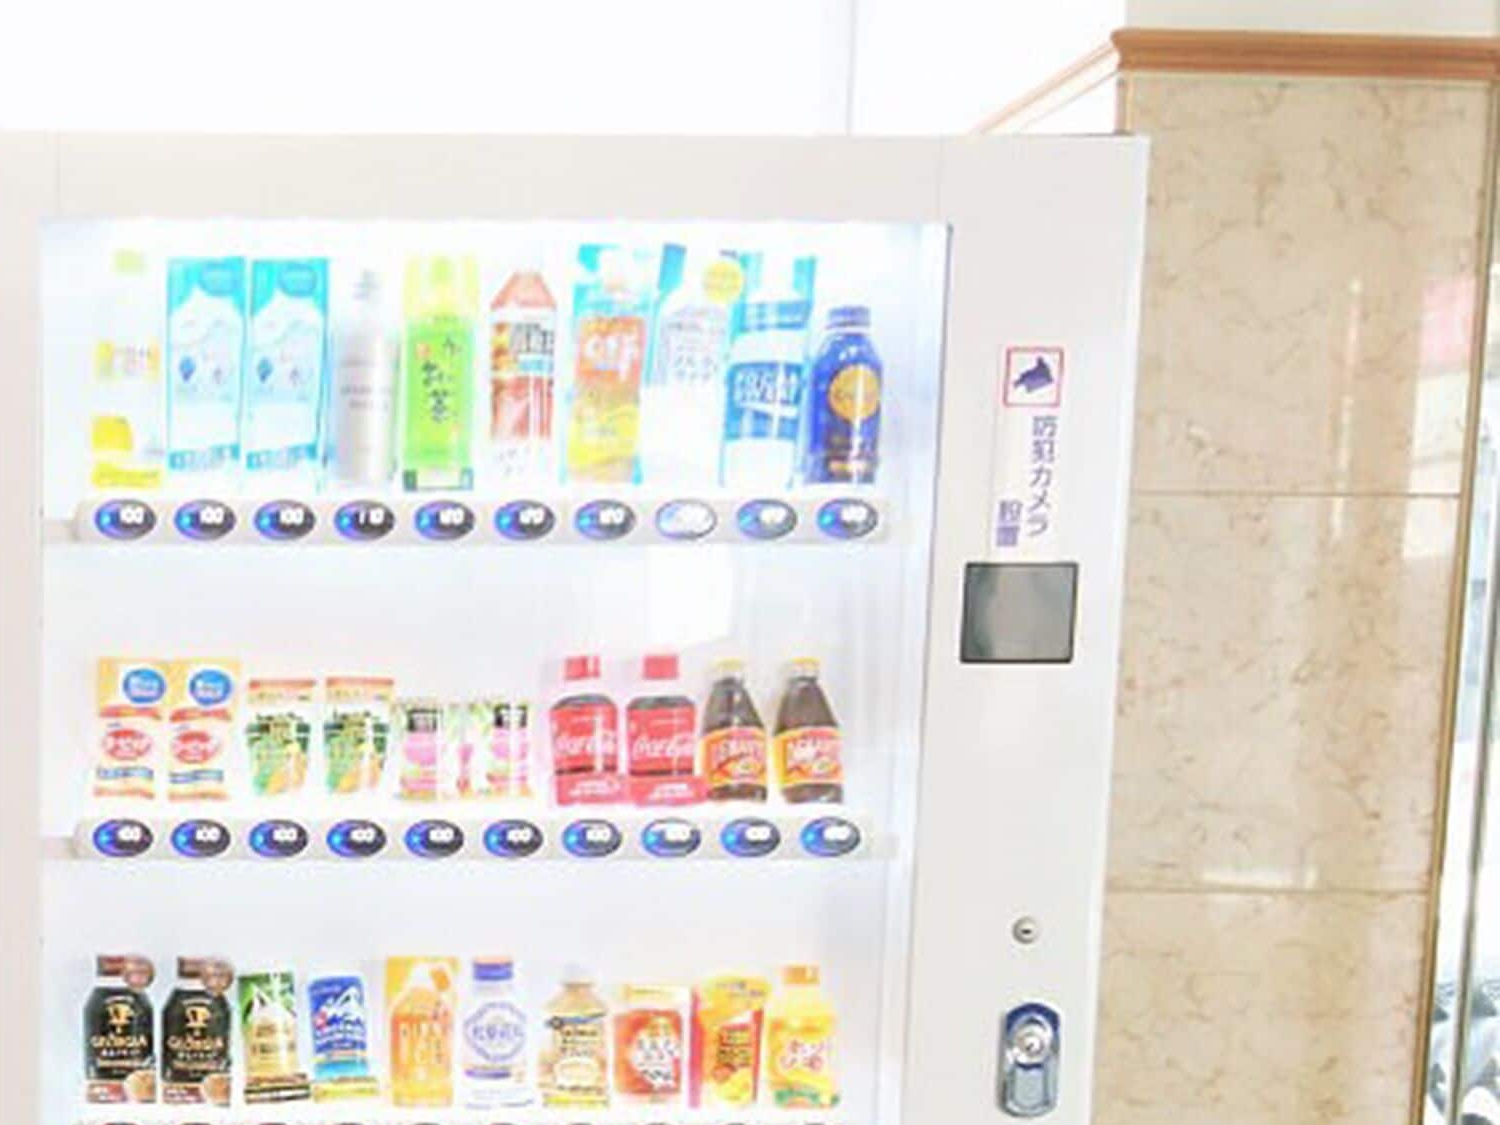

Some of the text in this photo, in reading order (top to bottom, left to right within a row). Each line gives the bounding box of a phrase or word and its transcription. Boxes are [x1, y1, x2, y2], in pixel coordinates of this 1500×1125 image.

[1028, 415, 1058, 537] 防犯カメラ
